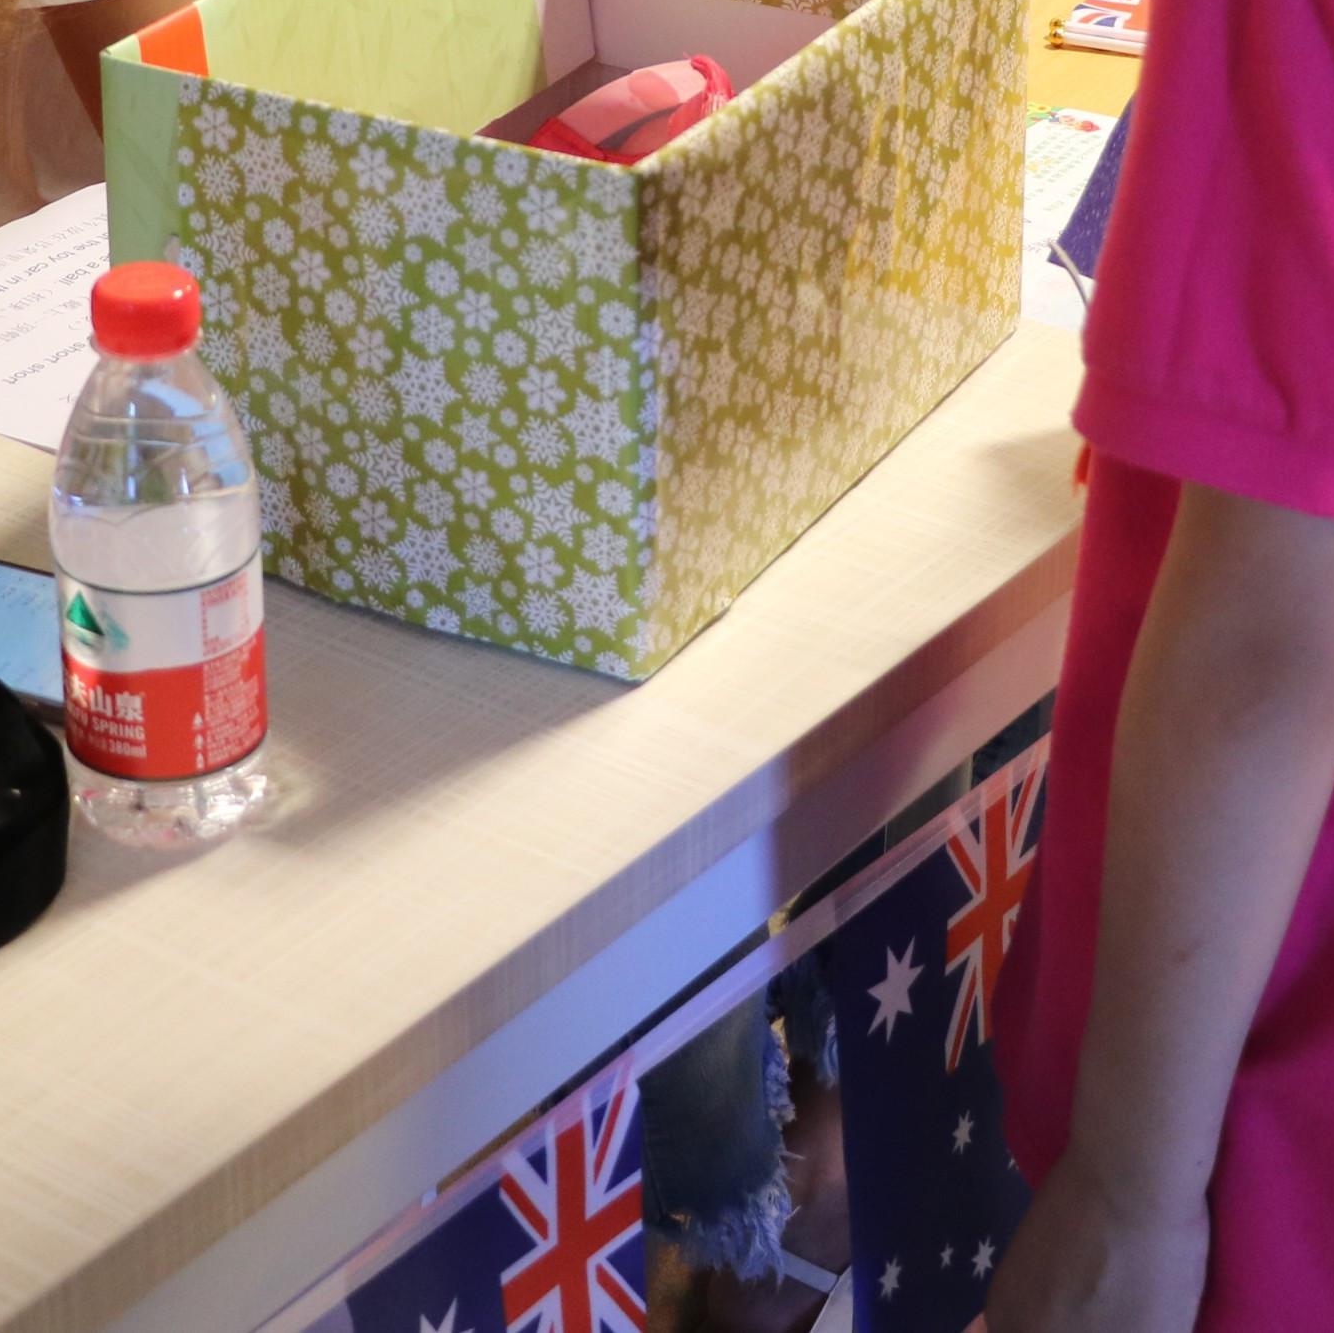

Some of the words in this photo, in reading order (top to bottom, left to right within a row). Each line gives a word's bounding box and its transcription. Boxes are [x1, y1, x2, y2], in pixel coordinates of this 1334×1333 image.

[23, 262, 49, 277] car
[43, 342, 85, 364] short
[1, 363, 45, 385] short
[91, 714, 145, 741] SPRING
